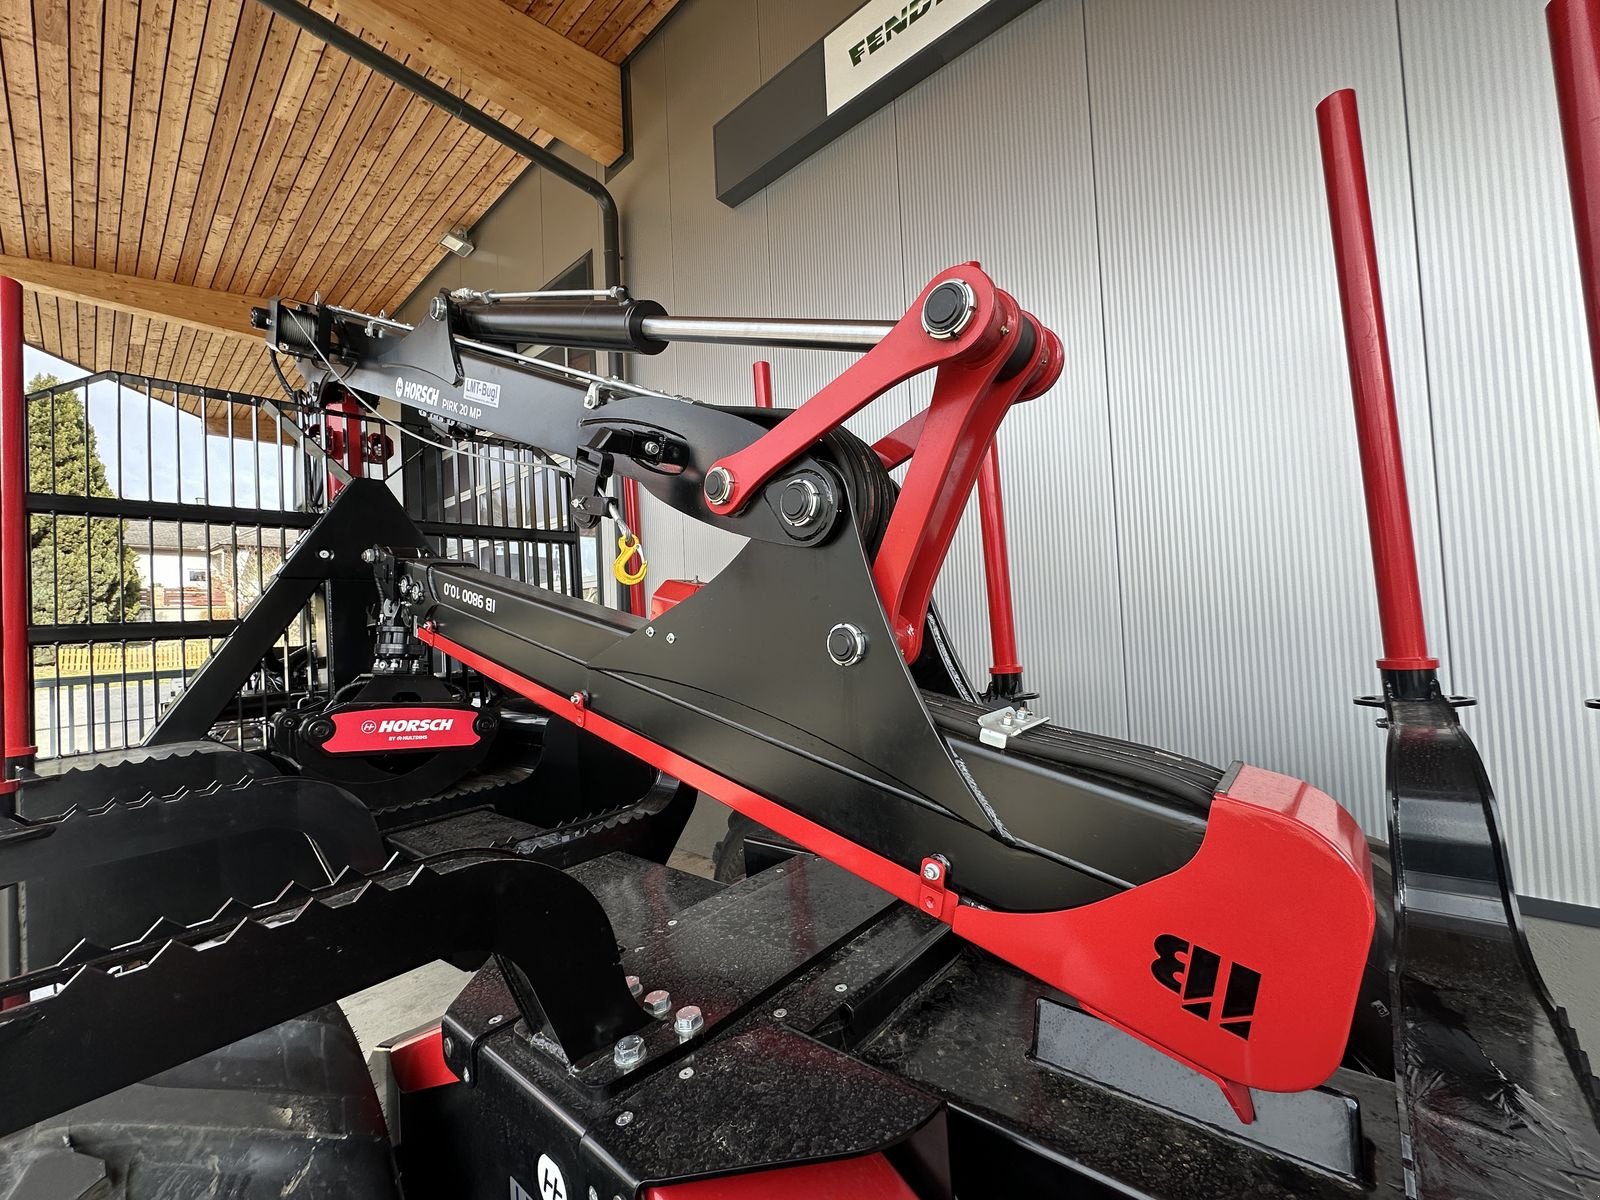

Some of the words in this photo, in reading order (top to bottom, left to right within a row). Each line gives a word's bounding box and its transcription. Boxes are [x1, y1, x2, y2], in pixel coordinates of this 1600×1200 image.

[848, 0, 943, 67] FEND
[403, 381, 440, 407] HORSCH
[459, 403, 468, 416] 20
[469, 406, 482, 420] MP
[443, 582, 460, 599] 10.0
[462, 589, 484, 609] 9800
[485, 597, 496, 613] IB
[378, 719, 454, 733] HORSCH
